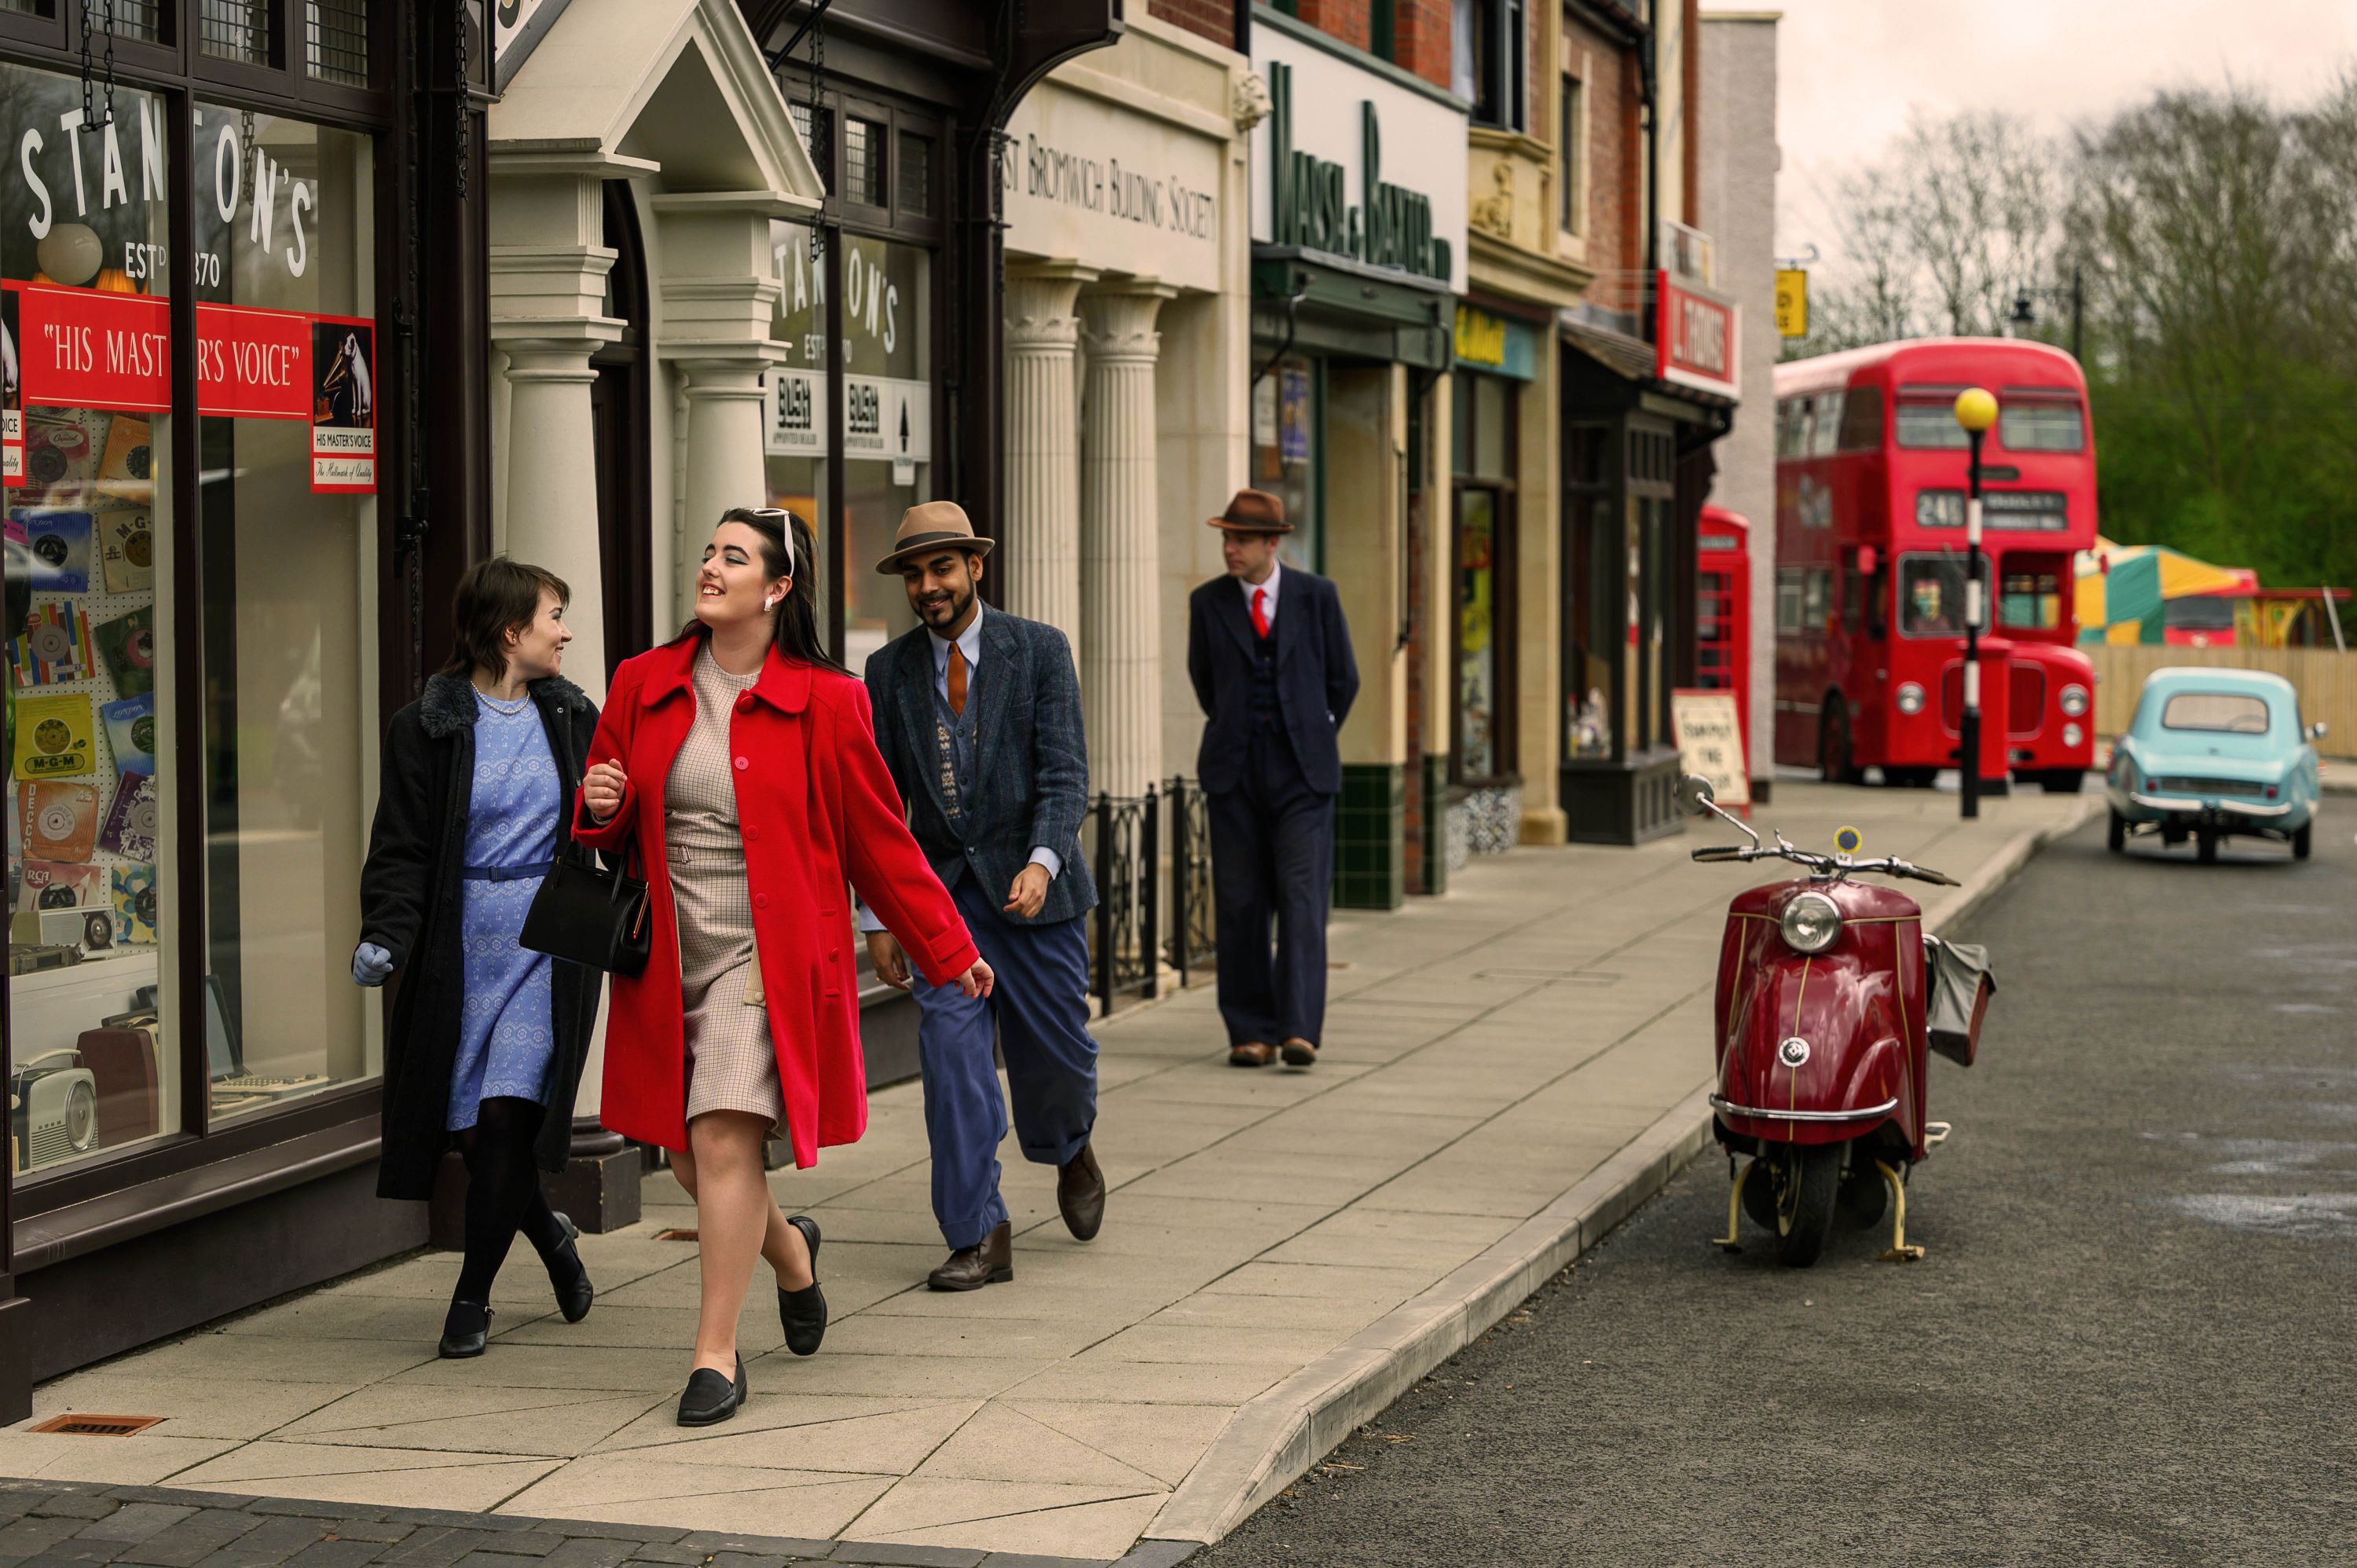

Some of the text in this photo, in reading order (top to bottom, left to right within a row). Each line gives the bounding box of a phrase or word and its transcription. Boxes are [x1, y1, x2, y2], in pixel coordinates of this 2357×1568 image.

[1028, 133, 1105, 213] BROMWICH
[1109, 158, 1164, 228] BUILDING
[1168, 174, 1217, 243] SOCIETY
[106, 332, 225, 383] MASTR'S
[316, 433, 372, 449] HIS MASTER'S VOICE
[316, 461, 372, 482] The Hallmark of Quality
[27, 870, 50, 883] RCA
